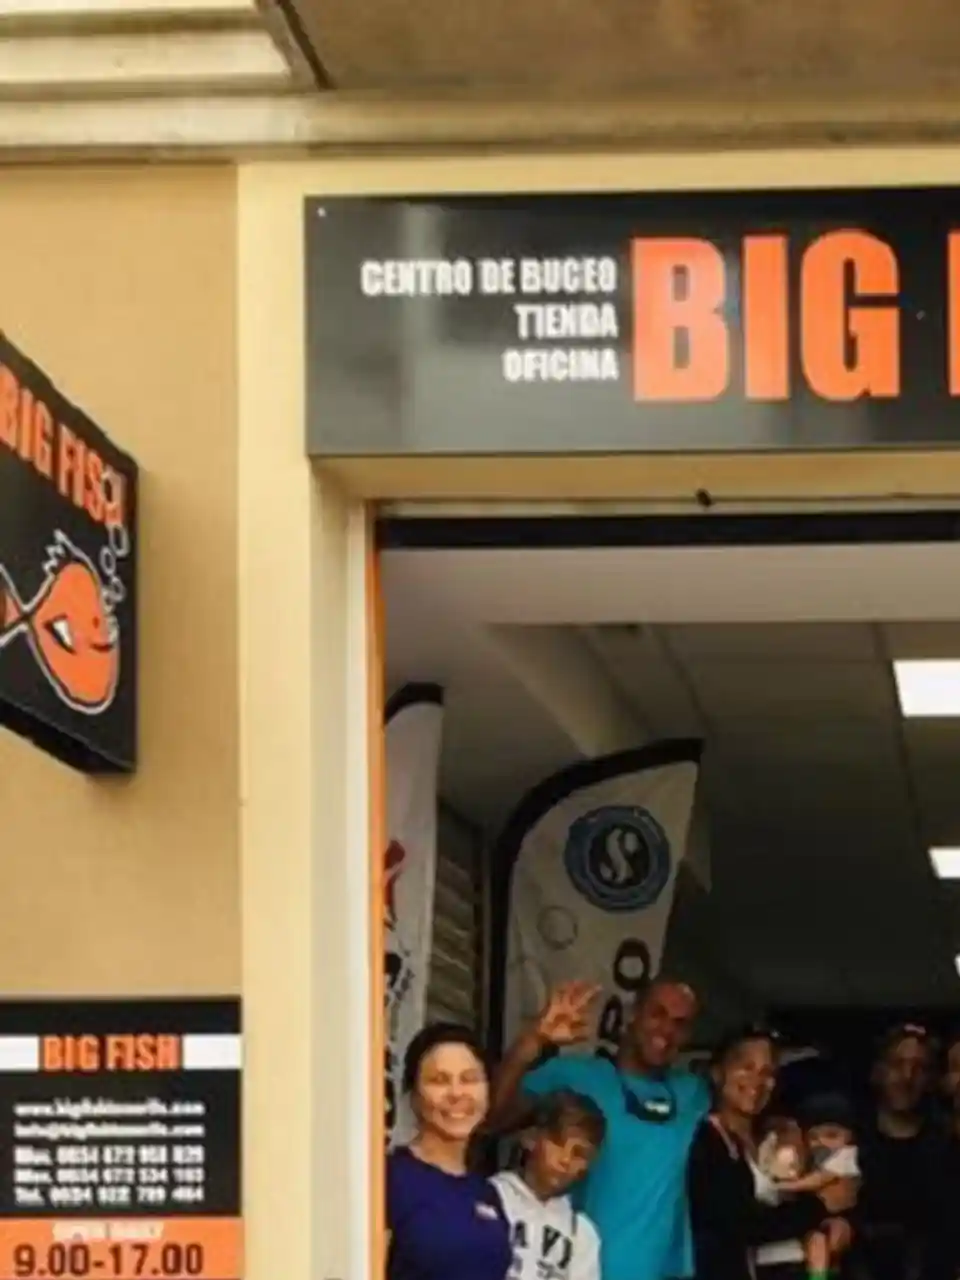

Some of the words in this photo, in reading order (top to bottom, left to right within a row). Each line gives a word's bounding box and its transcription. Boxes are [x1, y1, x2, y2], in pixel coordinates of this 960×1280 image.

[361, 260, 472, 296] CENTRO
[482, 260, 514, 293] DE
[521, 257, 617, 293] BUCEO
[515, 303, 618, 339] TIENDA
[631, 230, 900, 402] BIG
[503, 348, 619, 382] OFICINA
[0, 364, 53, 479] BIG
[43, 1035, 100, 1071] BIG
[106, 1034, 181, 1071] FISH
[14, 1243, 204, 1277] 9.00-17.00
